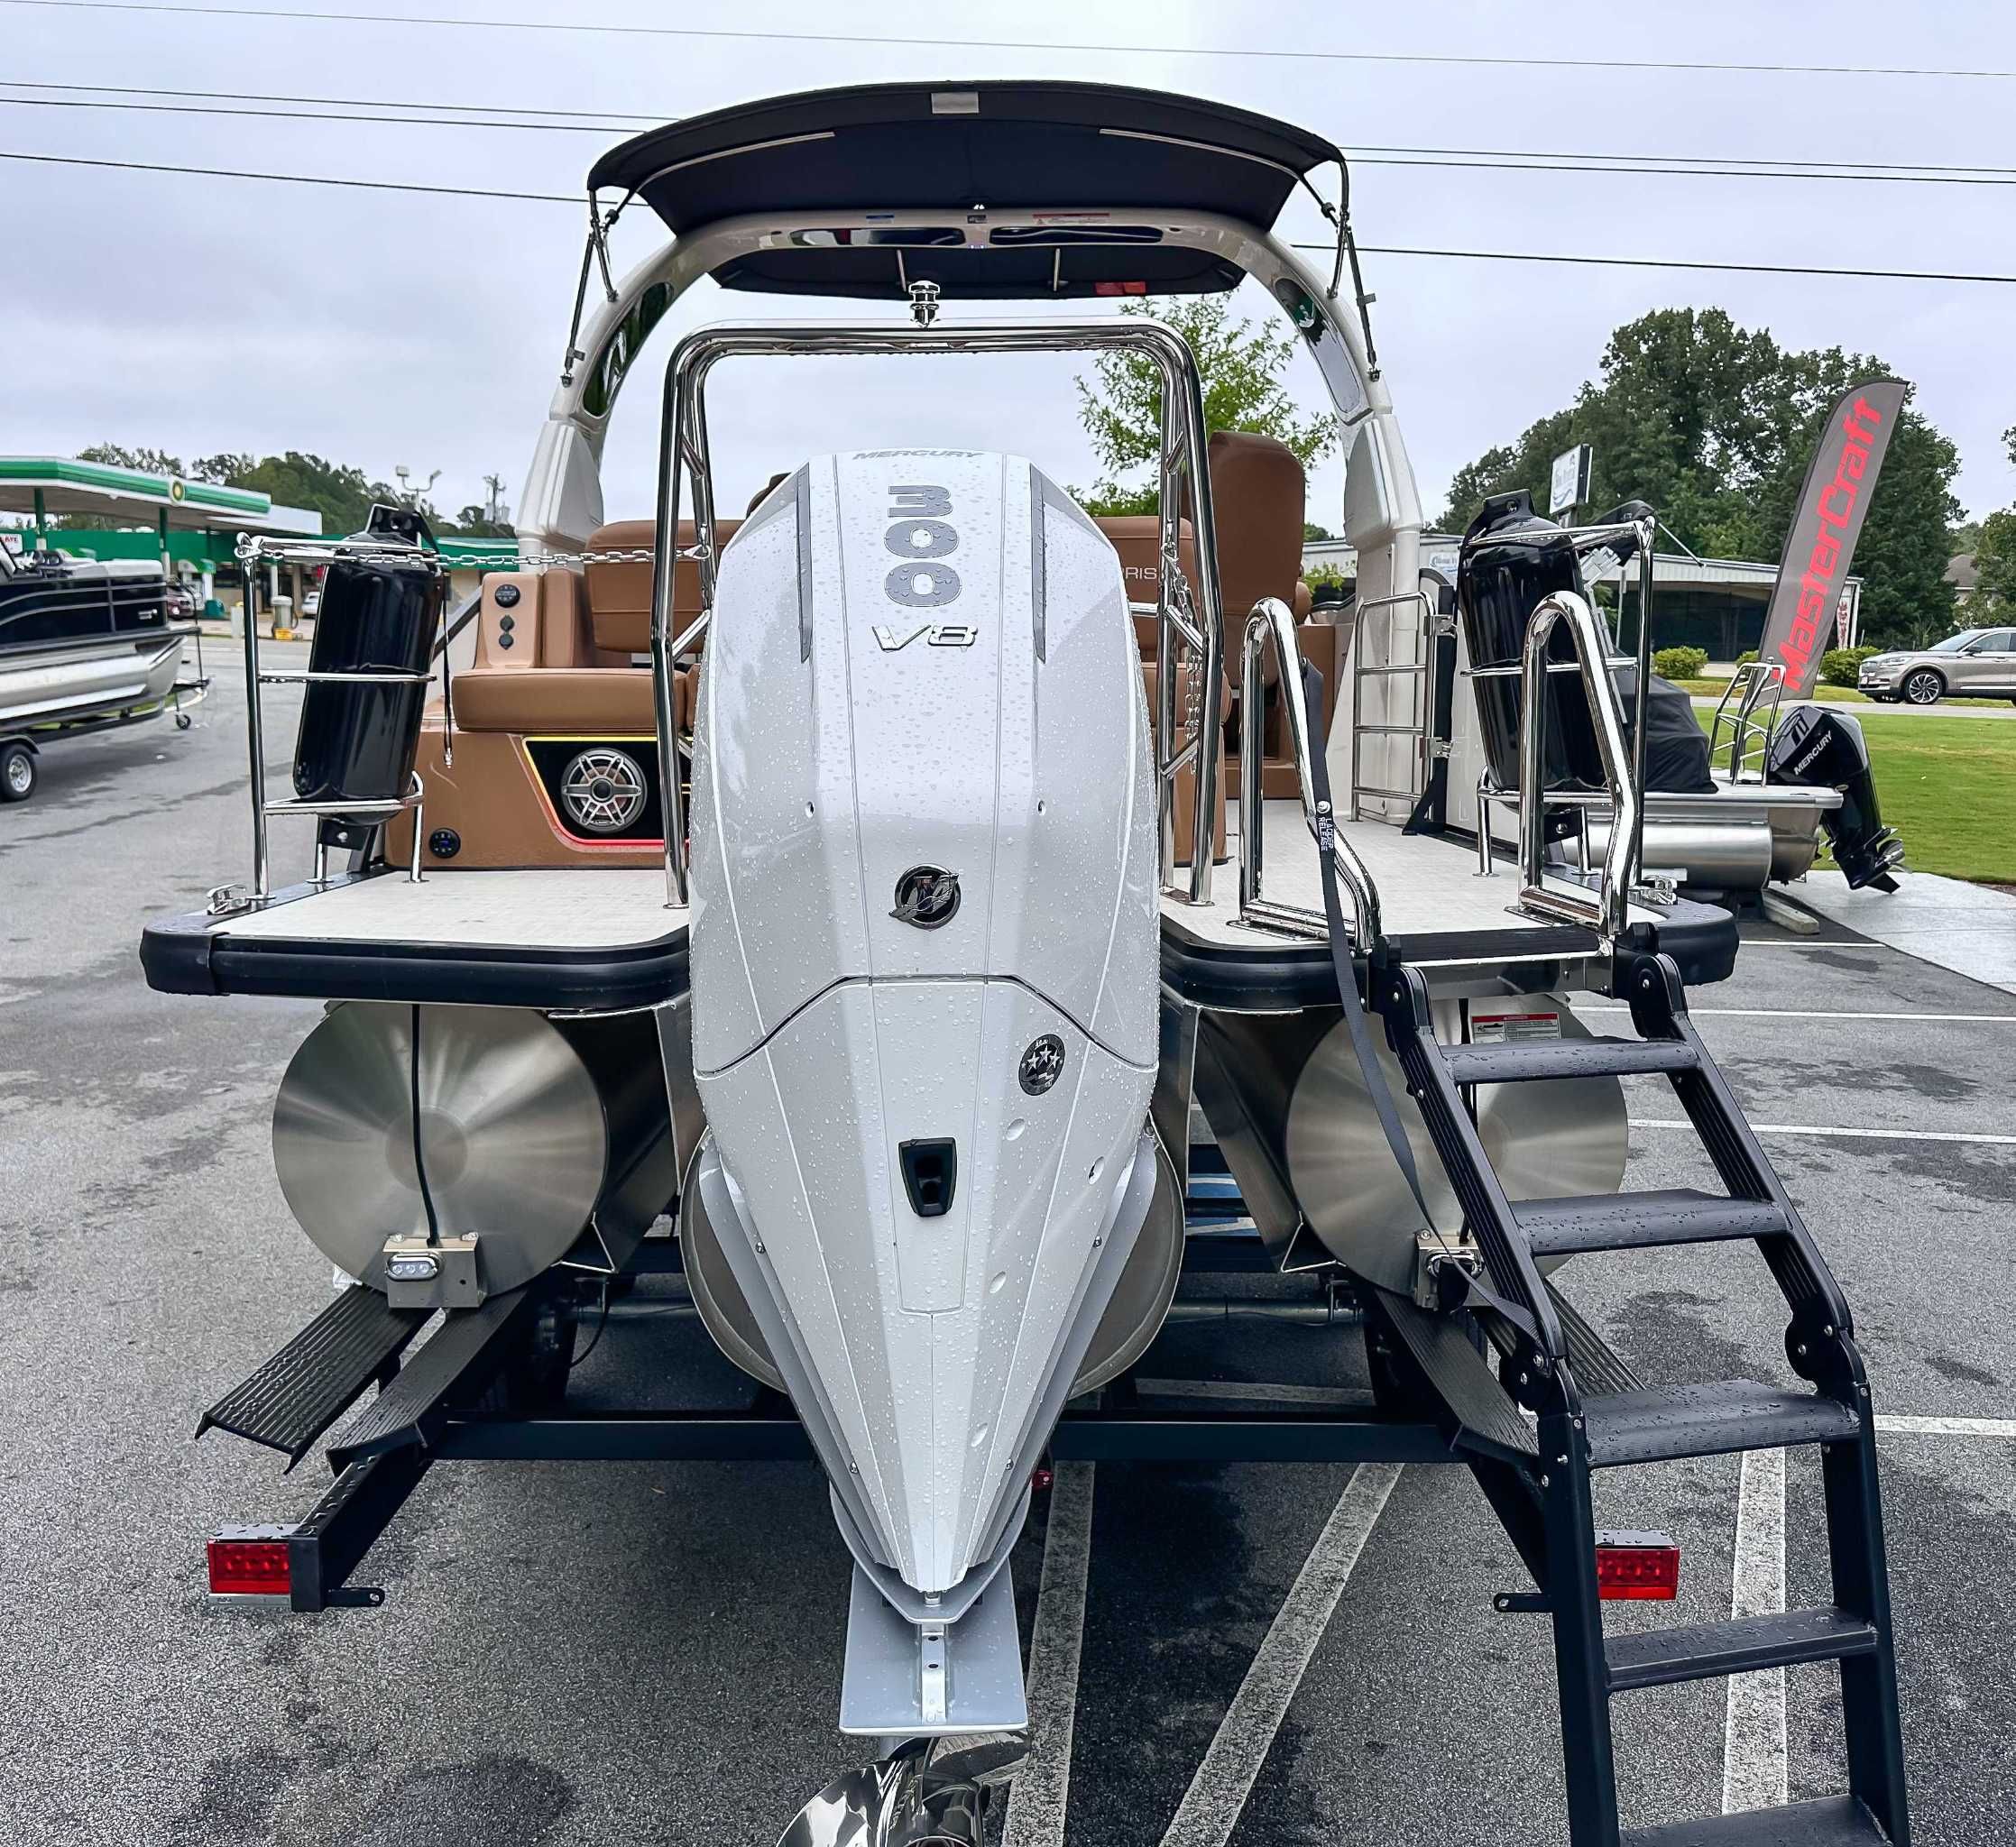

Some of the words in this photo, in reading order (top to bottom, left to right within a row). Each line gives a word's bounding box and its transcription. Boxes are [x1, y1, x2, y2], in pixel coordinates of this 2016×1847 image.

[852, 450, 985, 460] MERCURY
[884, 484, 962, 607] 300
[1772, 396, 1883, 692] MasterCraft
[1122, 566, 1157, 580] RIS
[871, 624, 978, 651] V8
[1793, 730, 1833, 776] MERCURY
[1318, 816, 1329, 851] RELEASE
[1325, 818, 1334, 849] LADDER
